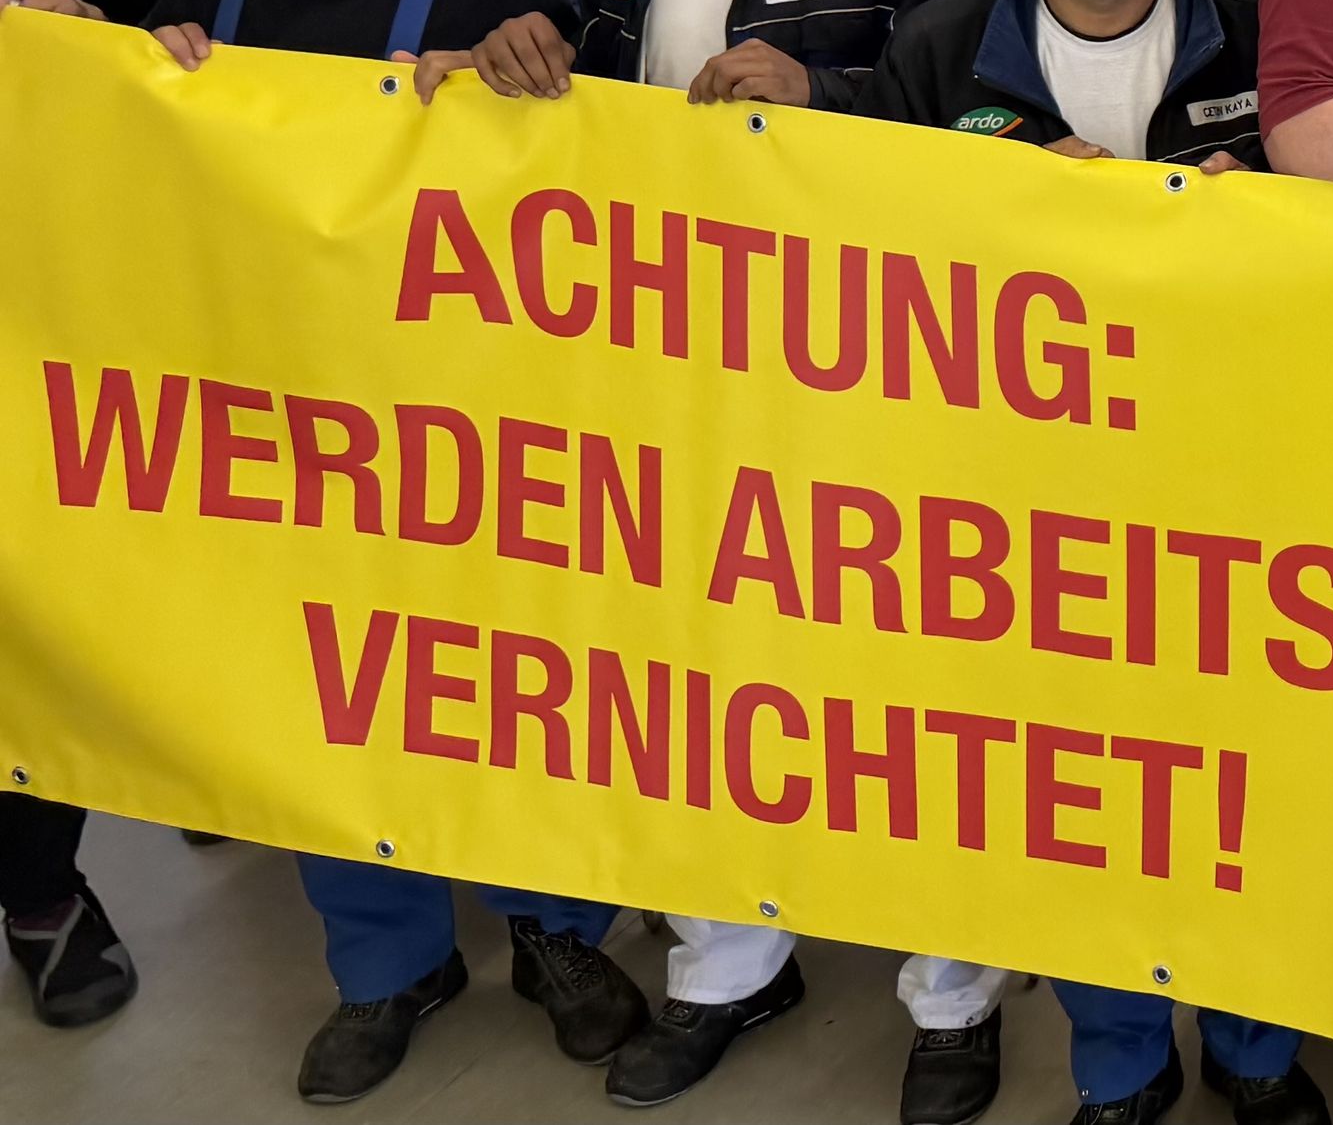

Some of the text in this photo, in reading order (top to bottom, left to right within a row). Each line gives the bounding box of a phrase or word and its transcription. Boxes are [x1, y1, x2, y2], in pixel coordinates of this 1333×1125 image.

[958, 114, 1004, 130] ardo
[395, 187, 1138, 431] ACHTUNG:
[43, 360, 663, 588] WERDEN
[302, 601, 1248, 893] VERNICHTET!
